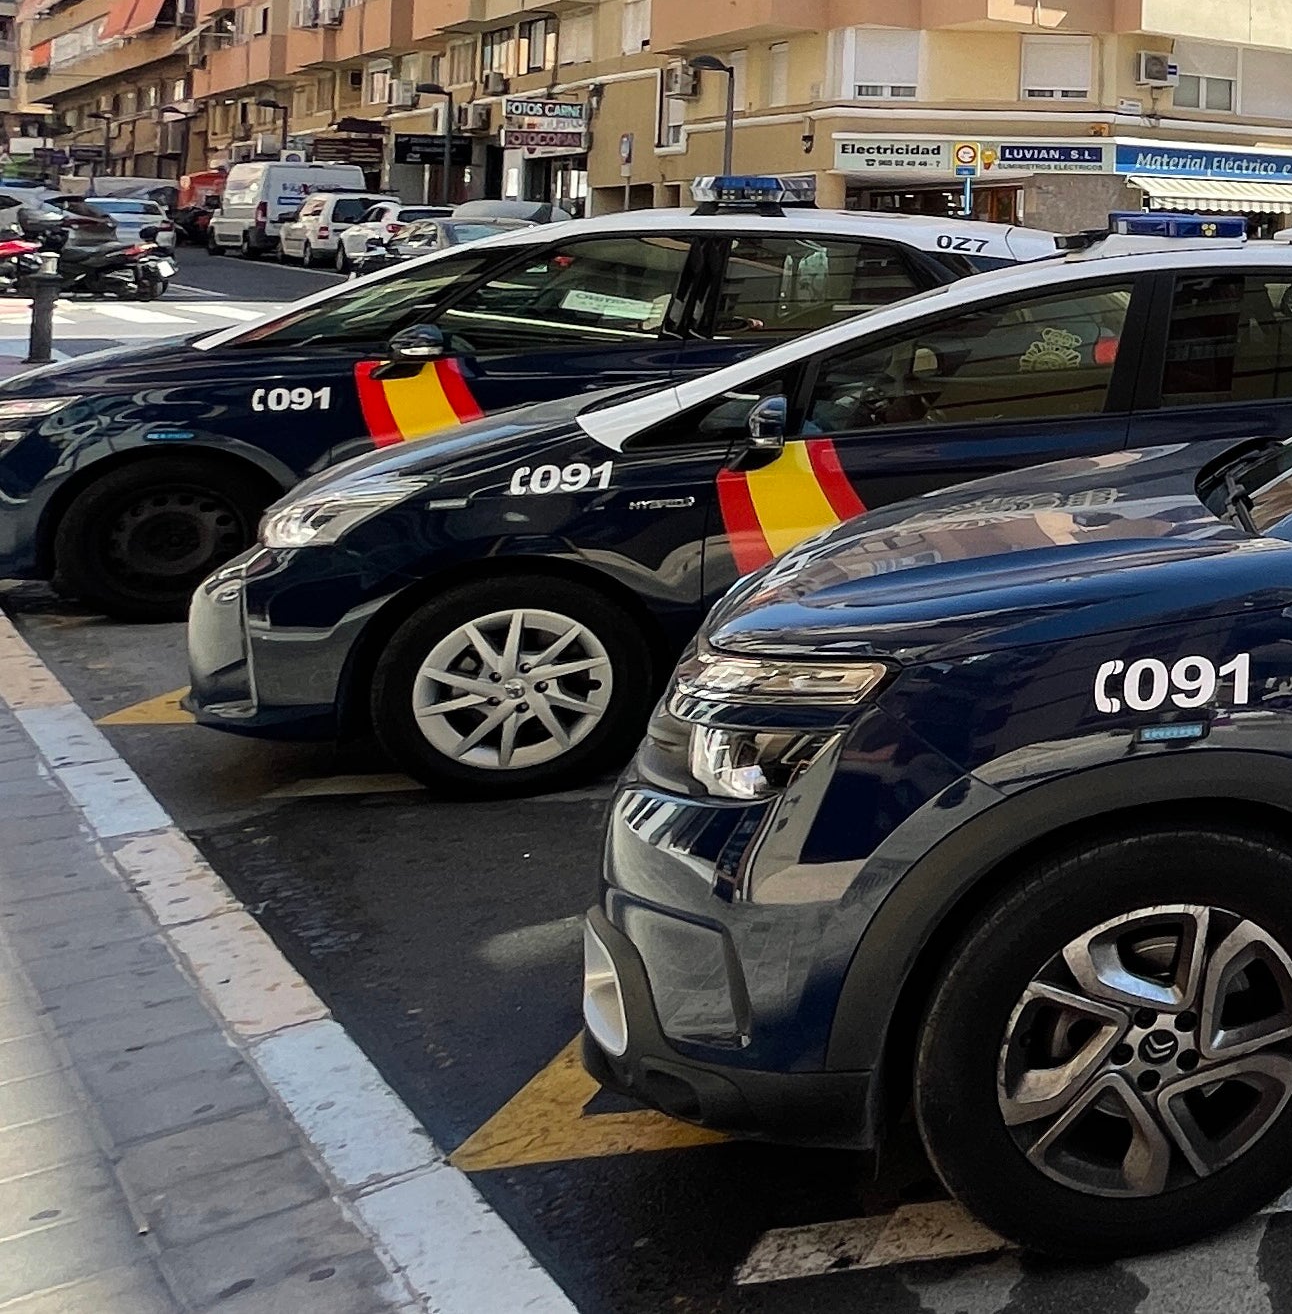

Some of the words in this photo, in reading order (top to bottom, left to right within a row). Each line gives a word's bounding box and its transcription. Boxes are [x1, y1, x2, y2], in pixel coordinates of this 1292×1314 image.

[507, 102, 542, 115] FOTOS
[840, 143, 941, 155] Electricidad
[1070, 149, 1096, 160] S.L.
[1135, 153, 1206, 171] Material
[1212, 156, 1277, 175] Eléctrico
[1282, 164, 1292, 175] e
[267, 387, 331, 411] 091
[529, 461, 613, 494] 091
[1124, 653, 1249, 711] 091
